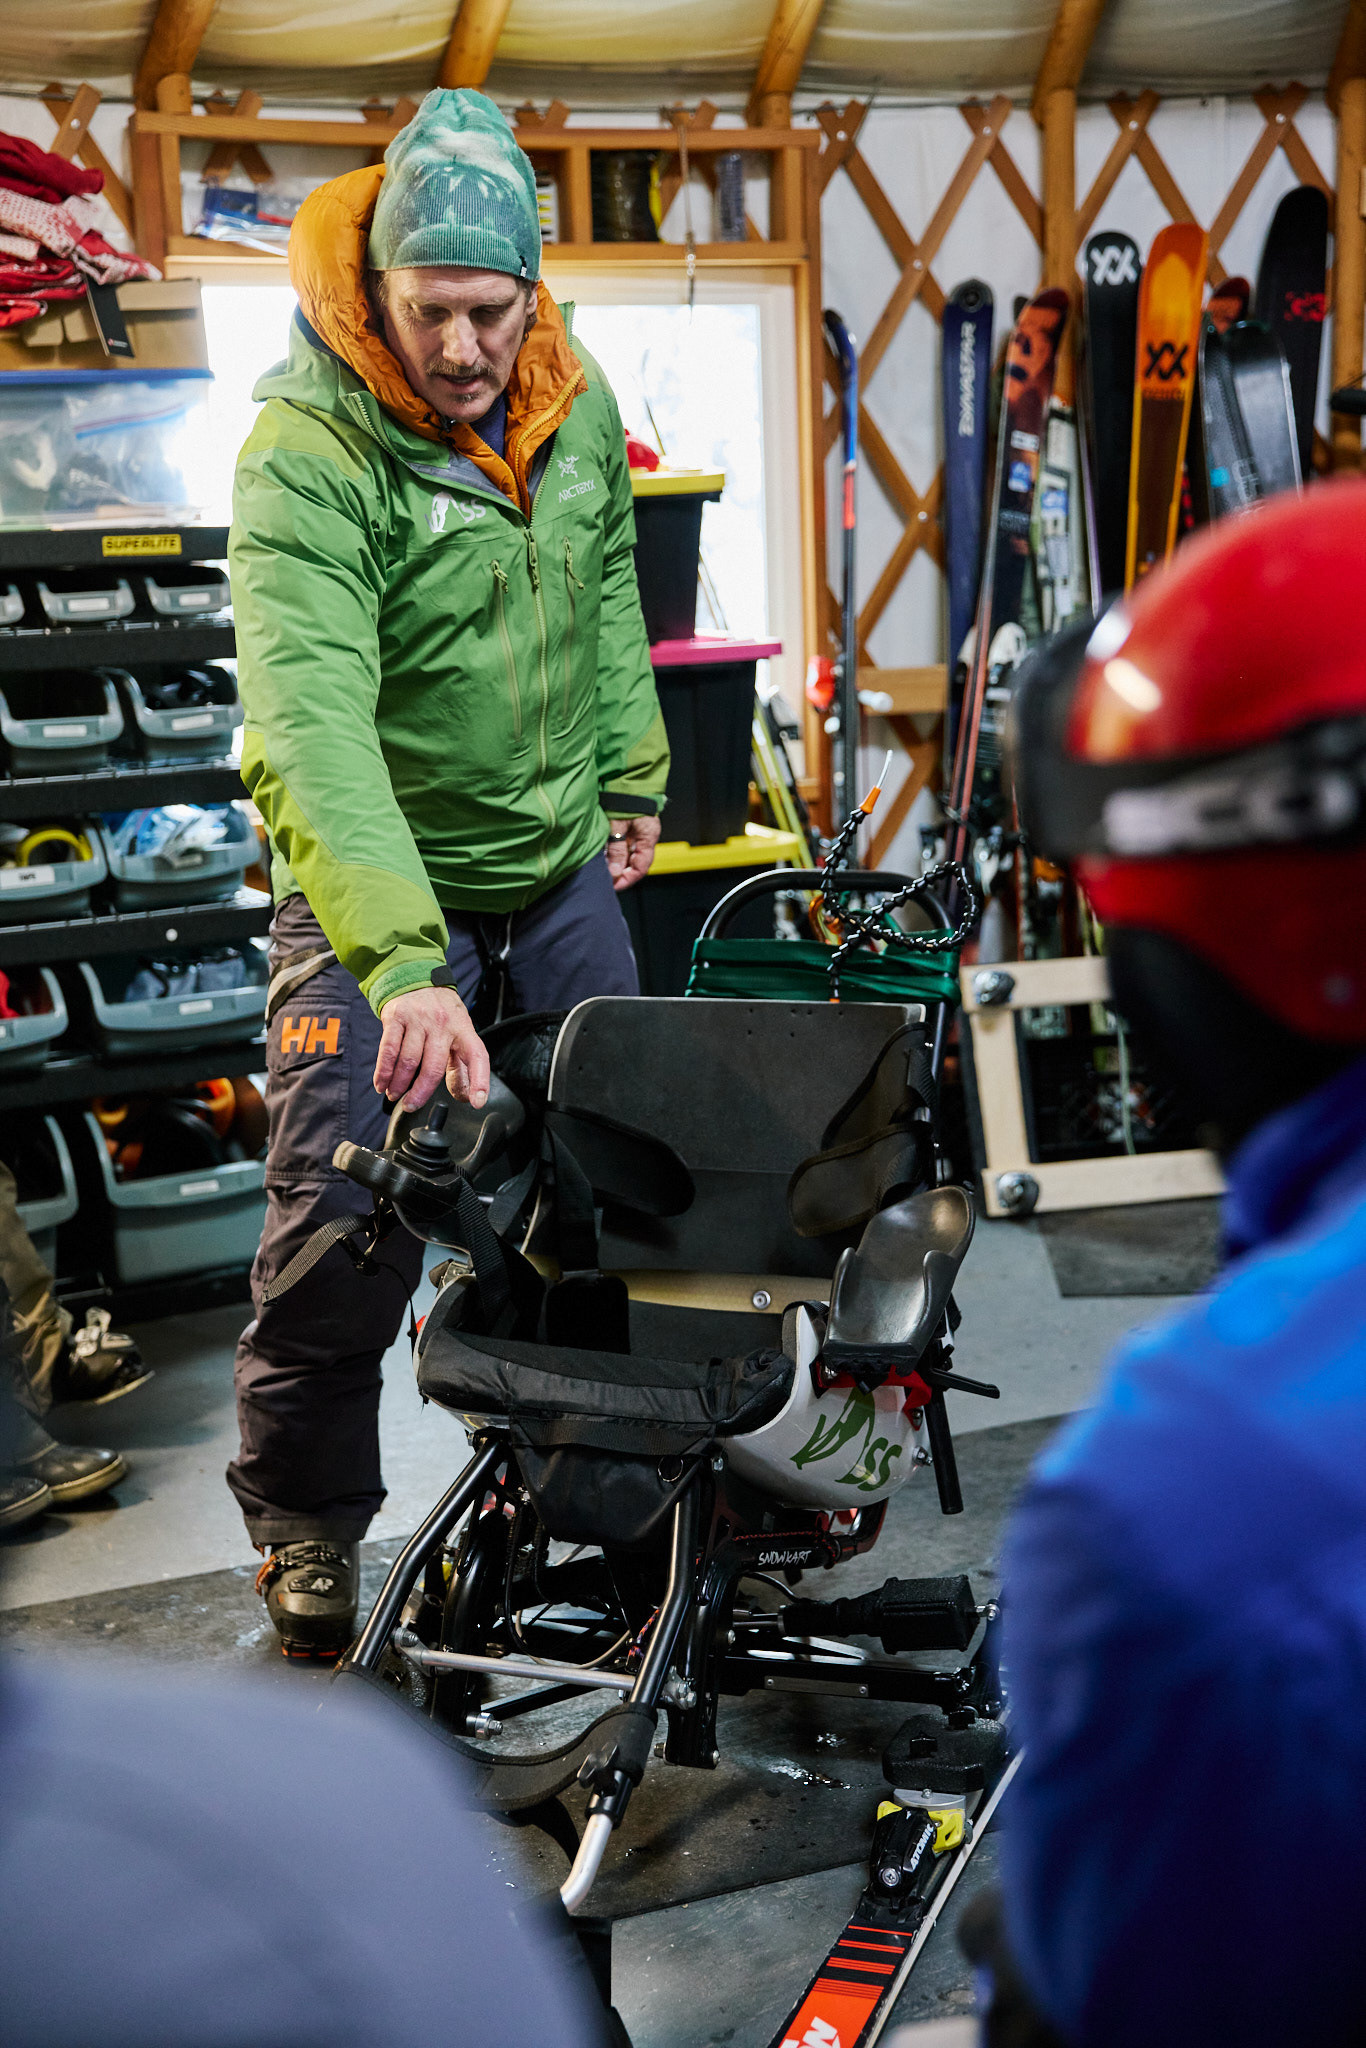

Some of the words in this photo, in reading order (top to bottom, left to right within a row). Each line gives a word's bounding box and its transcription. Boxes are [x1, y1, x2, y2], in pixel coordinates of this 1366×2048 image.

[106, 537, 177, 549] SUPERLITE
[281, 1016, 341, 1054] HH
[910, 1823, 934, 1871] ATOMIC
